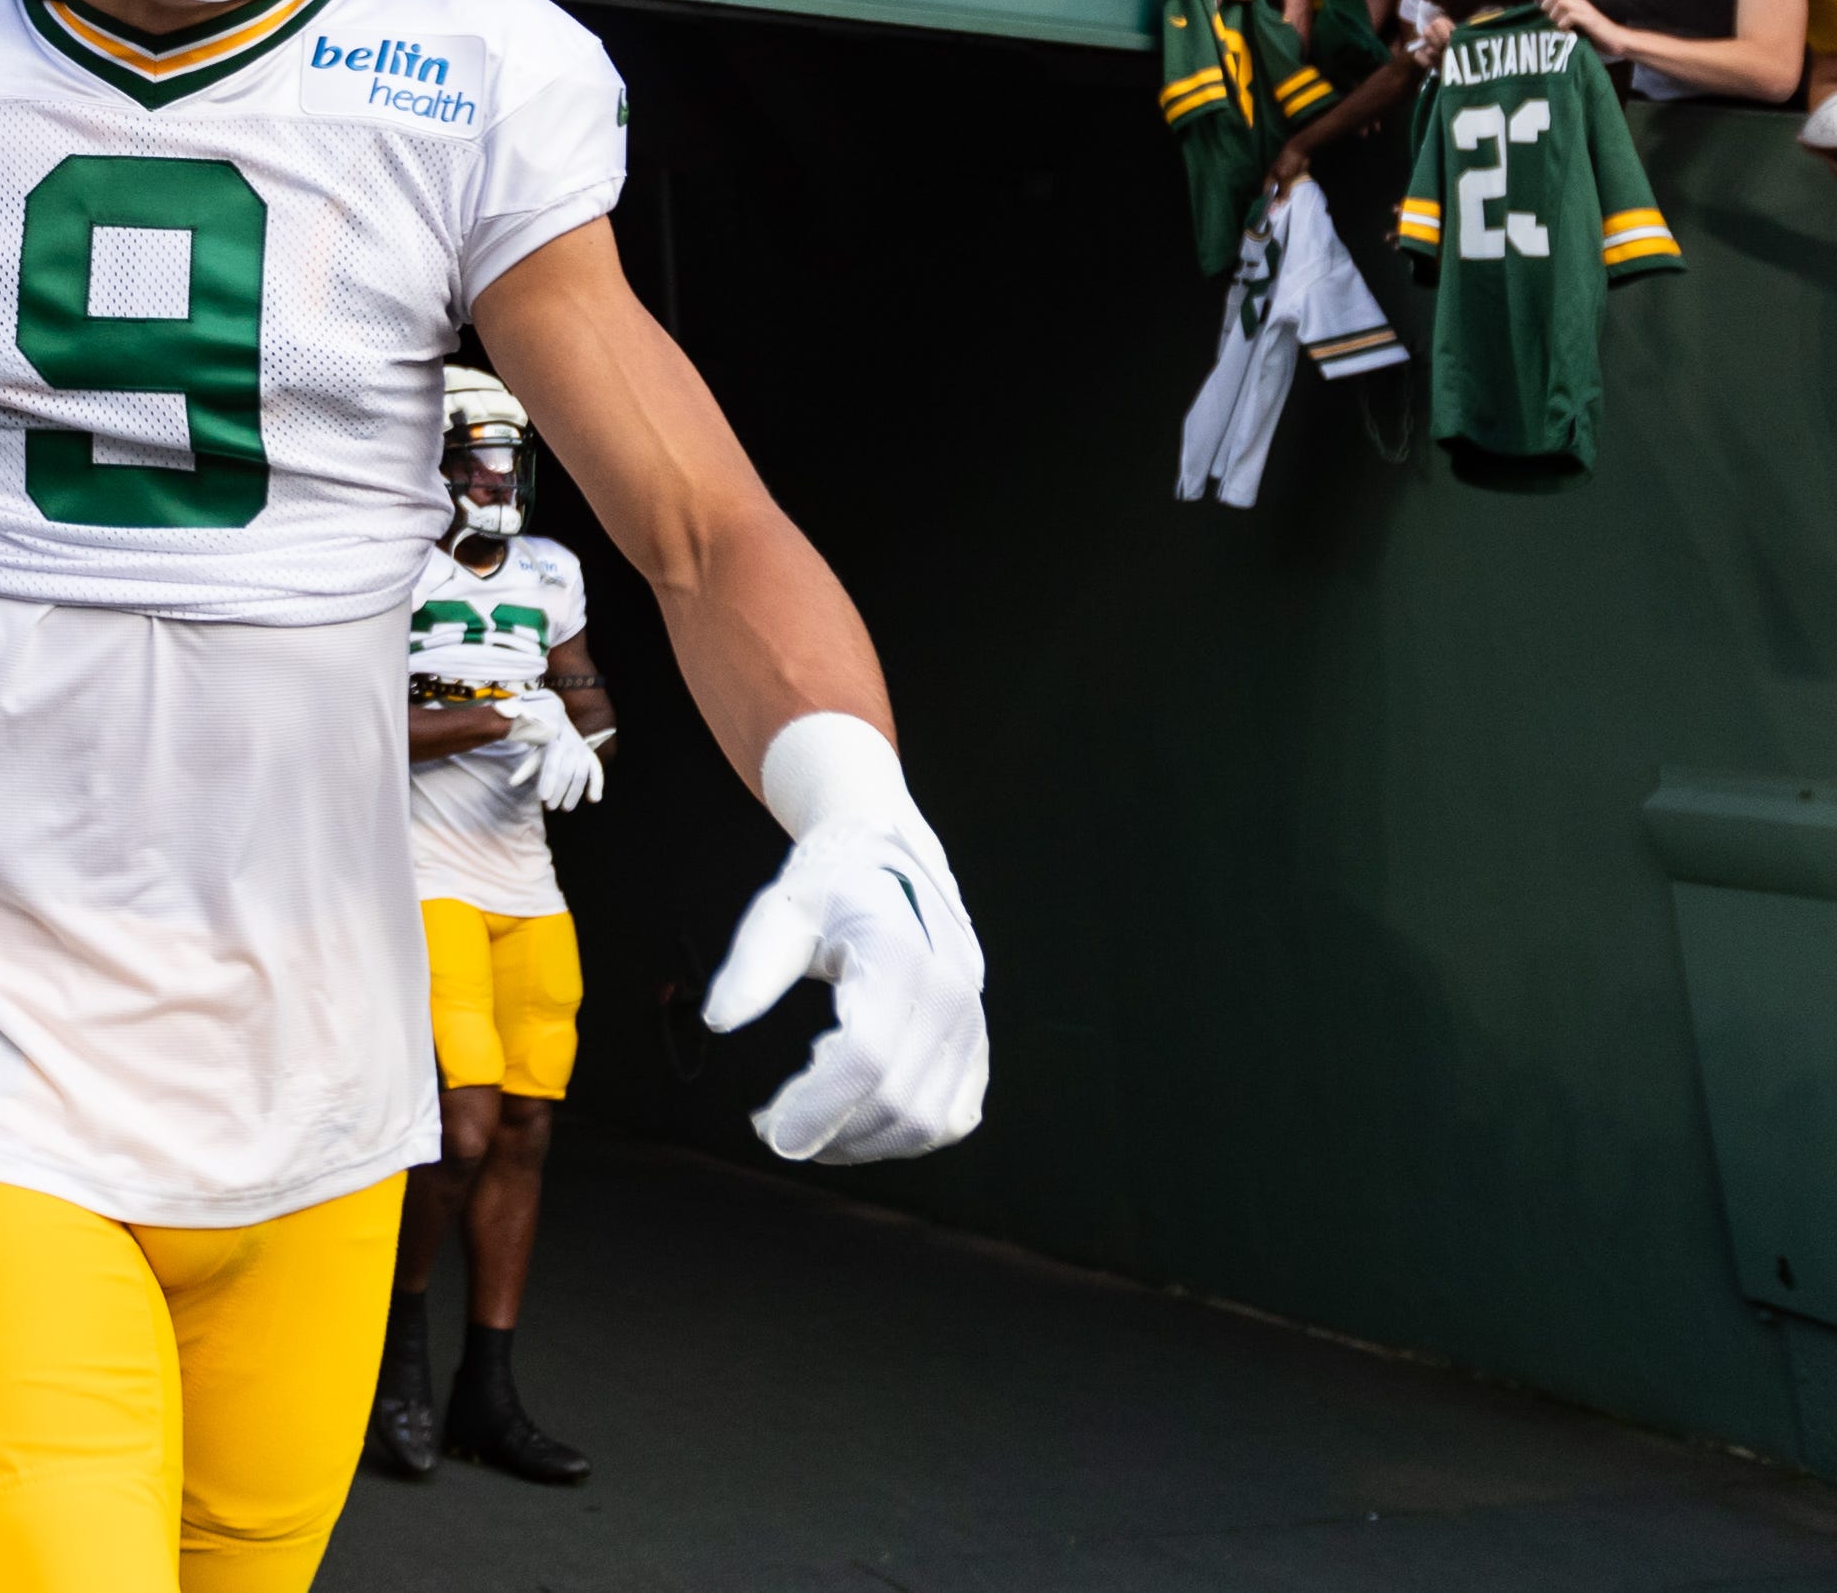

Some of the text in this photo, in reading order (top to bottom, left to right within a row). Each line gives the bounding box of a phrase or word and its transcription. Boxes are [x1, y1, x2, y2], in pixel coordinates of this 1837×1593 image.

[311, 36, 449, 85] bellin
[369, 77, 476, 125] health
[16, 154, 269, 528] 9
